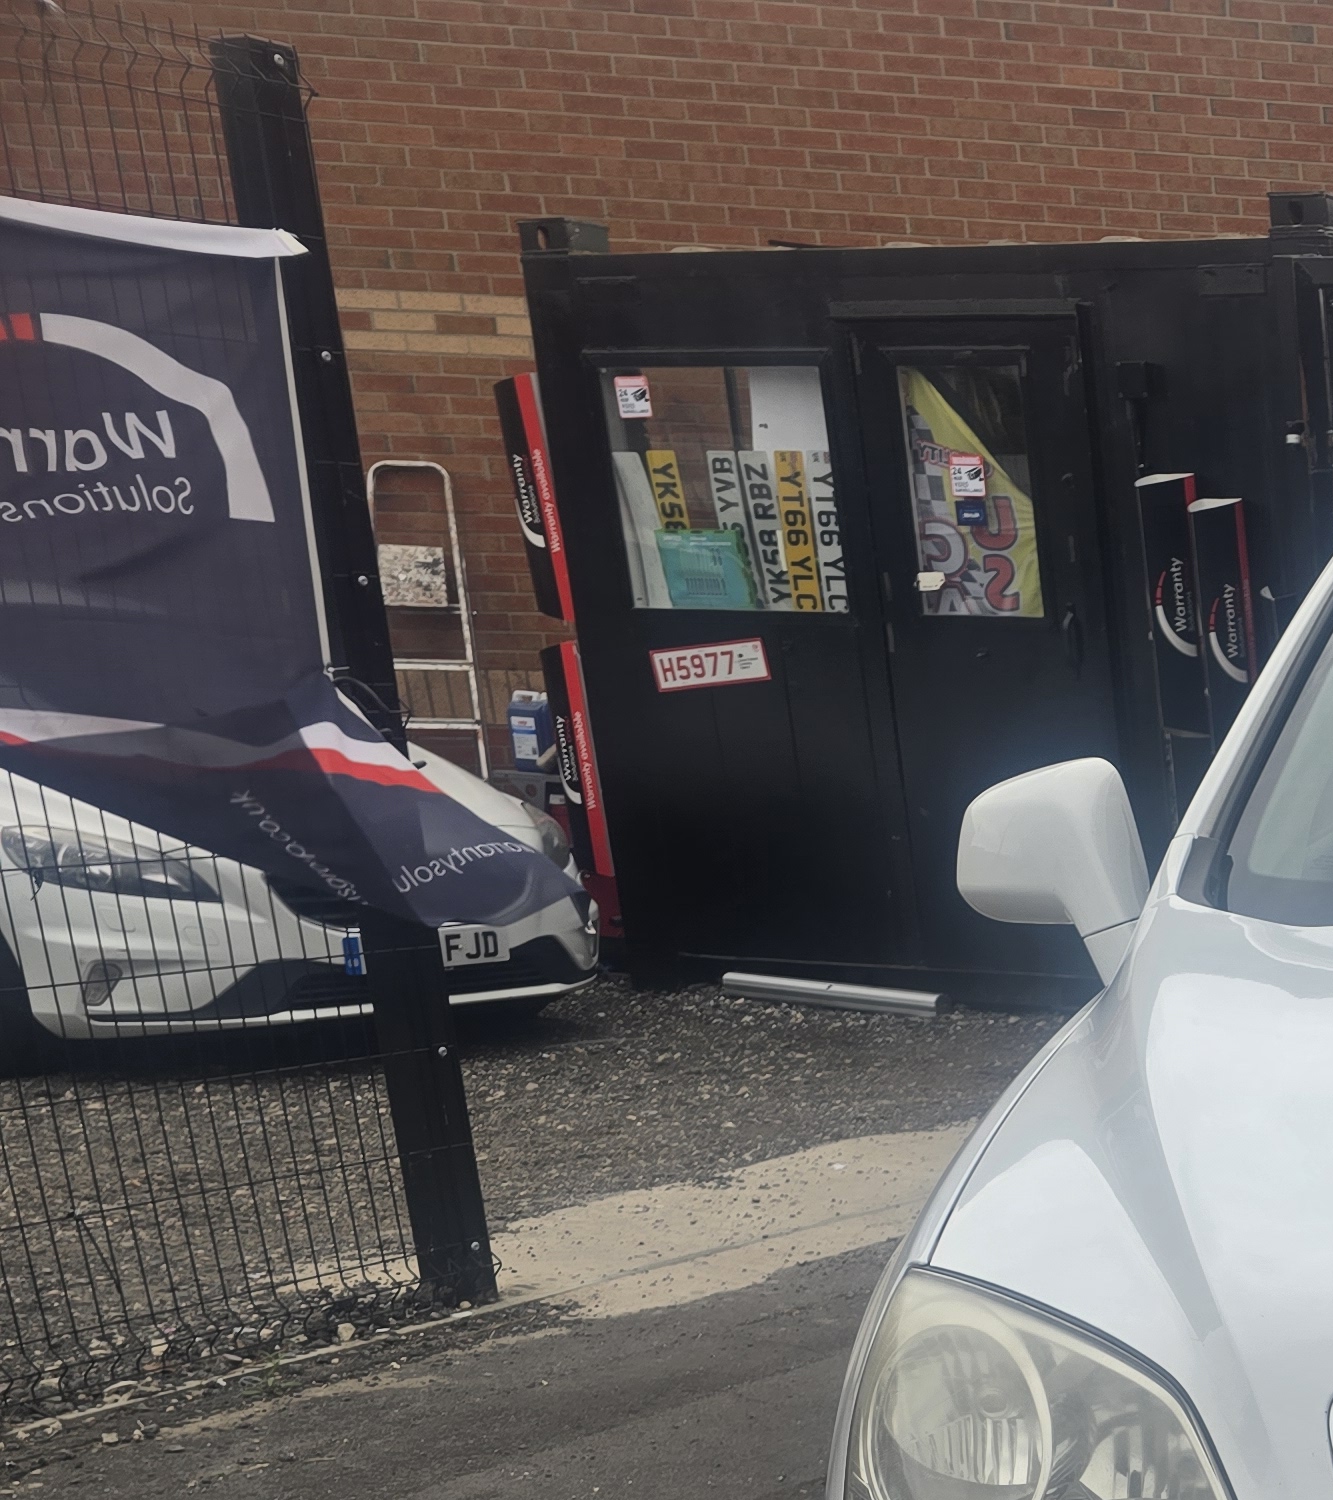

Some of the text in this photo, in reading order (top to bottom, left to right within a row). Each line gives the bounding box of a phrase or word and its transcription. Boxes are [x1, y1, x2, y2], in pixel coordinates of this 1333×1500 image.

[512, 453, 533, 524] Warranty
[744, 463, 777, 520] RBZ
[544, 501, 561, 553] Warranty
[780, 471, 818, 611] YT66 YLC
[1170, 557, 1187, 632] Warranty
[1222, 583, 1239, 658] Warranty
[658, 650, 734, 682] H5977
[556, 715, 573, 781] Warranty
[444, 930, 499, 962] FJD
